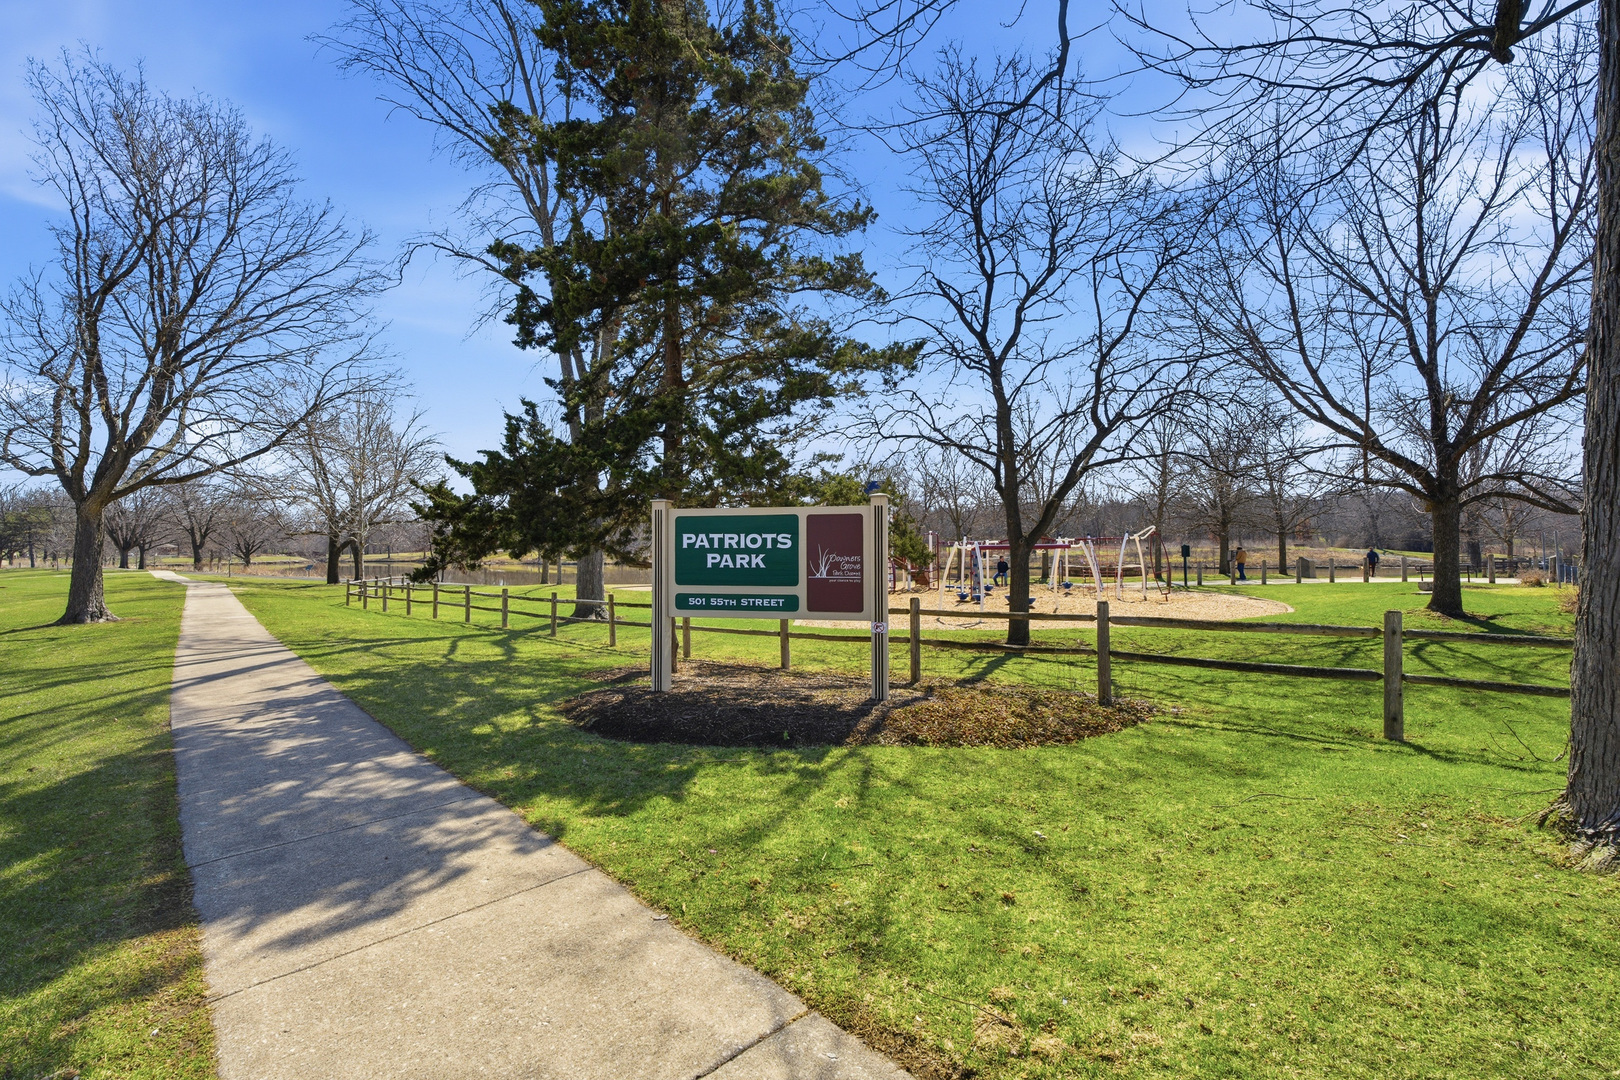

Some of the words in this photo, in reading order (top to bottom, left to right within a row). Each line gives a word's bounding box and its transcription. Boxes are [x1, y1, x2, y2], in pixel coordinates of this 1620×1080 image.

[682, 533, 792, 549] PATRIOTS
[706, 553, 766, 568] PARK
[829, 554, 861, 562] Downers
[840, 561, 861, 570] Grove
[688, 597, 706, 605] 501
[710, 598, 737, 606] 55TH
[740, 598, 785, 607] STREET
